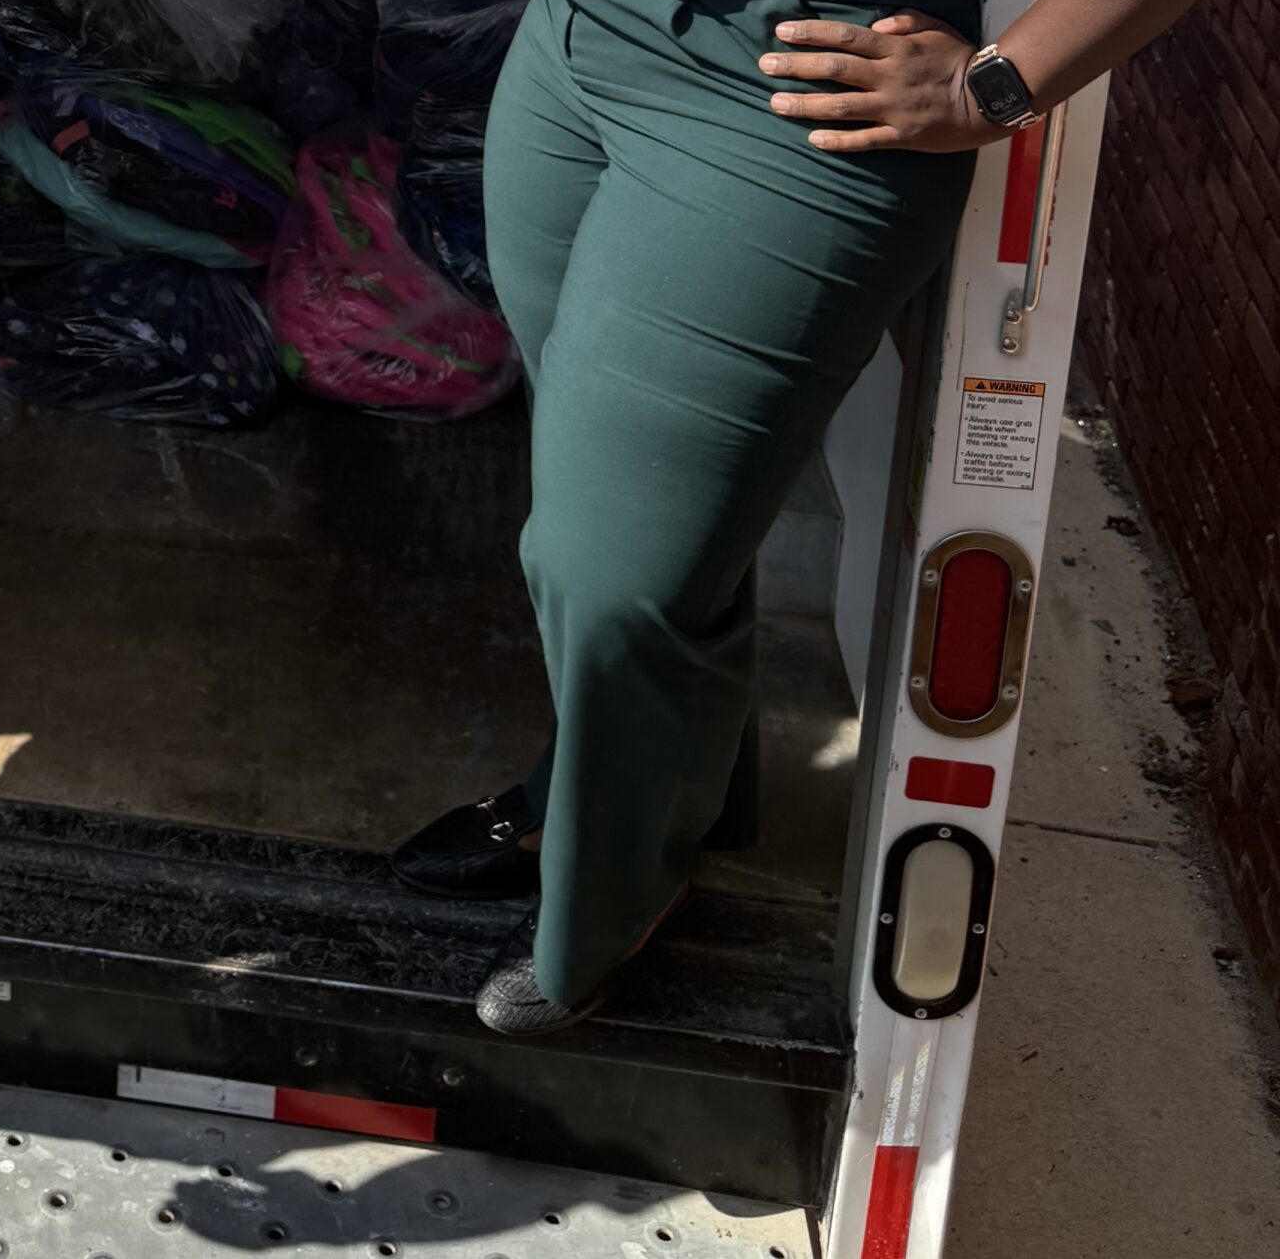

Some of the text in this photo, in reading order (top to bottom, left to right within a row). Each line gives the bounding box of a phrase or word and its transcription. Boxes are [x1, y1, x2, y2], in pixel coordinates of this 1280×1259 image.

[990, 381, 1036, 393] WARNING
[969, 416, 997, 425] Always
[968, 424, 993, 432] handle
[967, 432, 998, 441] entering
[1010, 436, 1035, 444] exiting
[964, 451, 993, 459] Always
[989, 460, 1013, 468] before
[963, 467, 993, 476] entering
[1006, 470, 1031, 478] exiting
